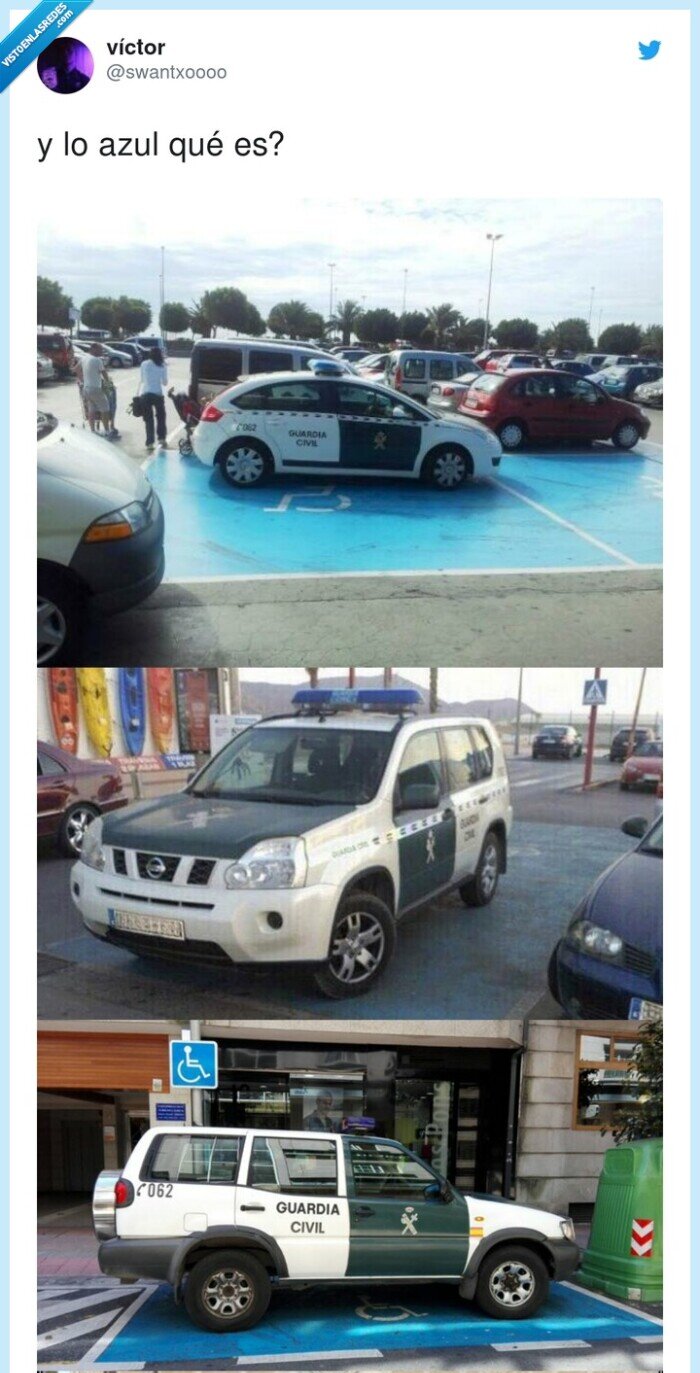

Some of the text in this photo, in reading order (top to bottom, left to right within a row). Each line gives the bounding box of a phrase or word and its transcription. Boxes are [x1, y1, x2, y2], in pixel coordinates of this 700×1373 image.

[288, 429, 327, 439] GUARDIA
[296, 438, 318, 447] CIVIL
[147, 1183, 173, 1198] 062
[276, 1201, 340, 1216] GUARDIA
[290, 1220, 325, 1234] CIVIL
